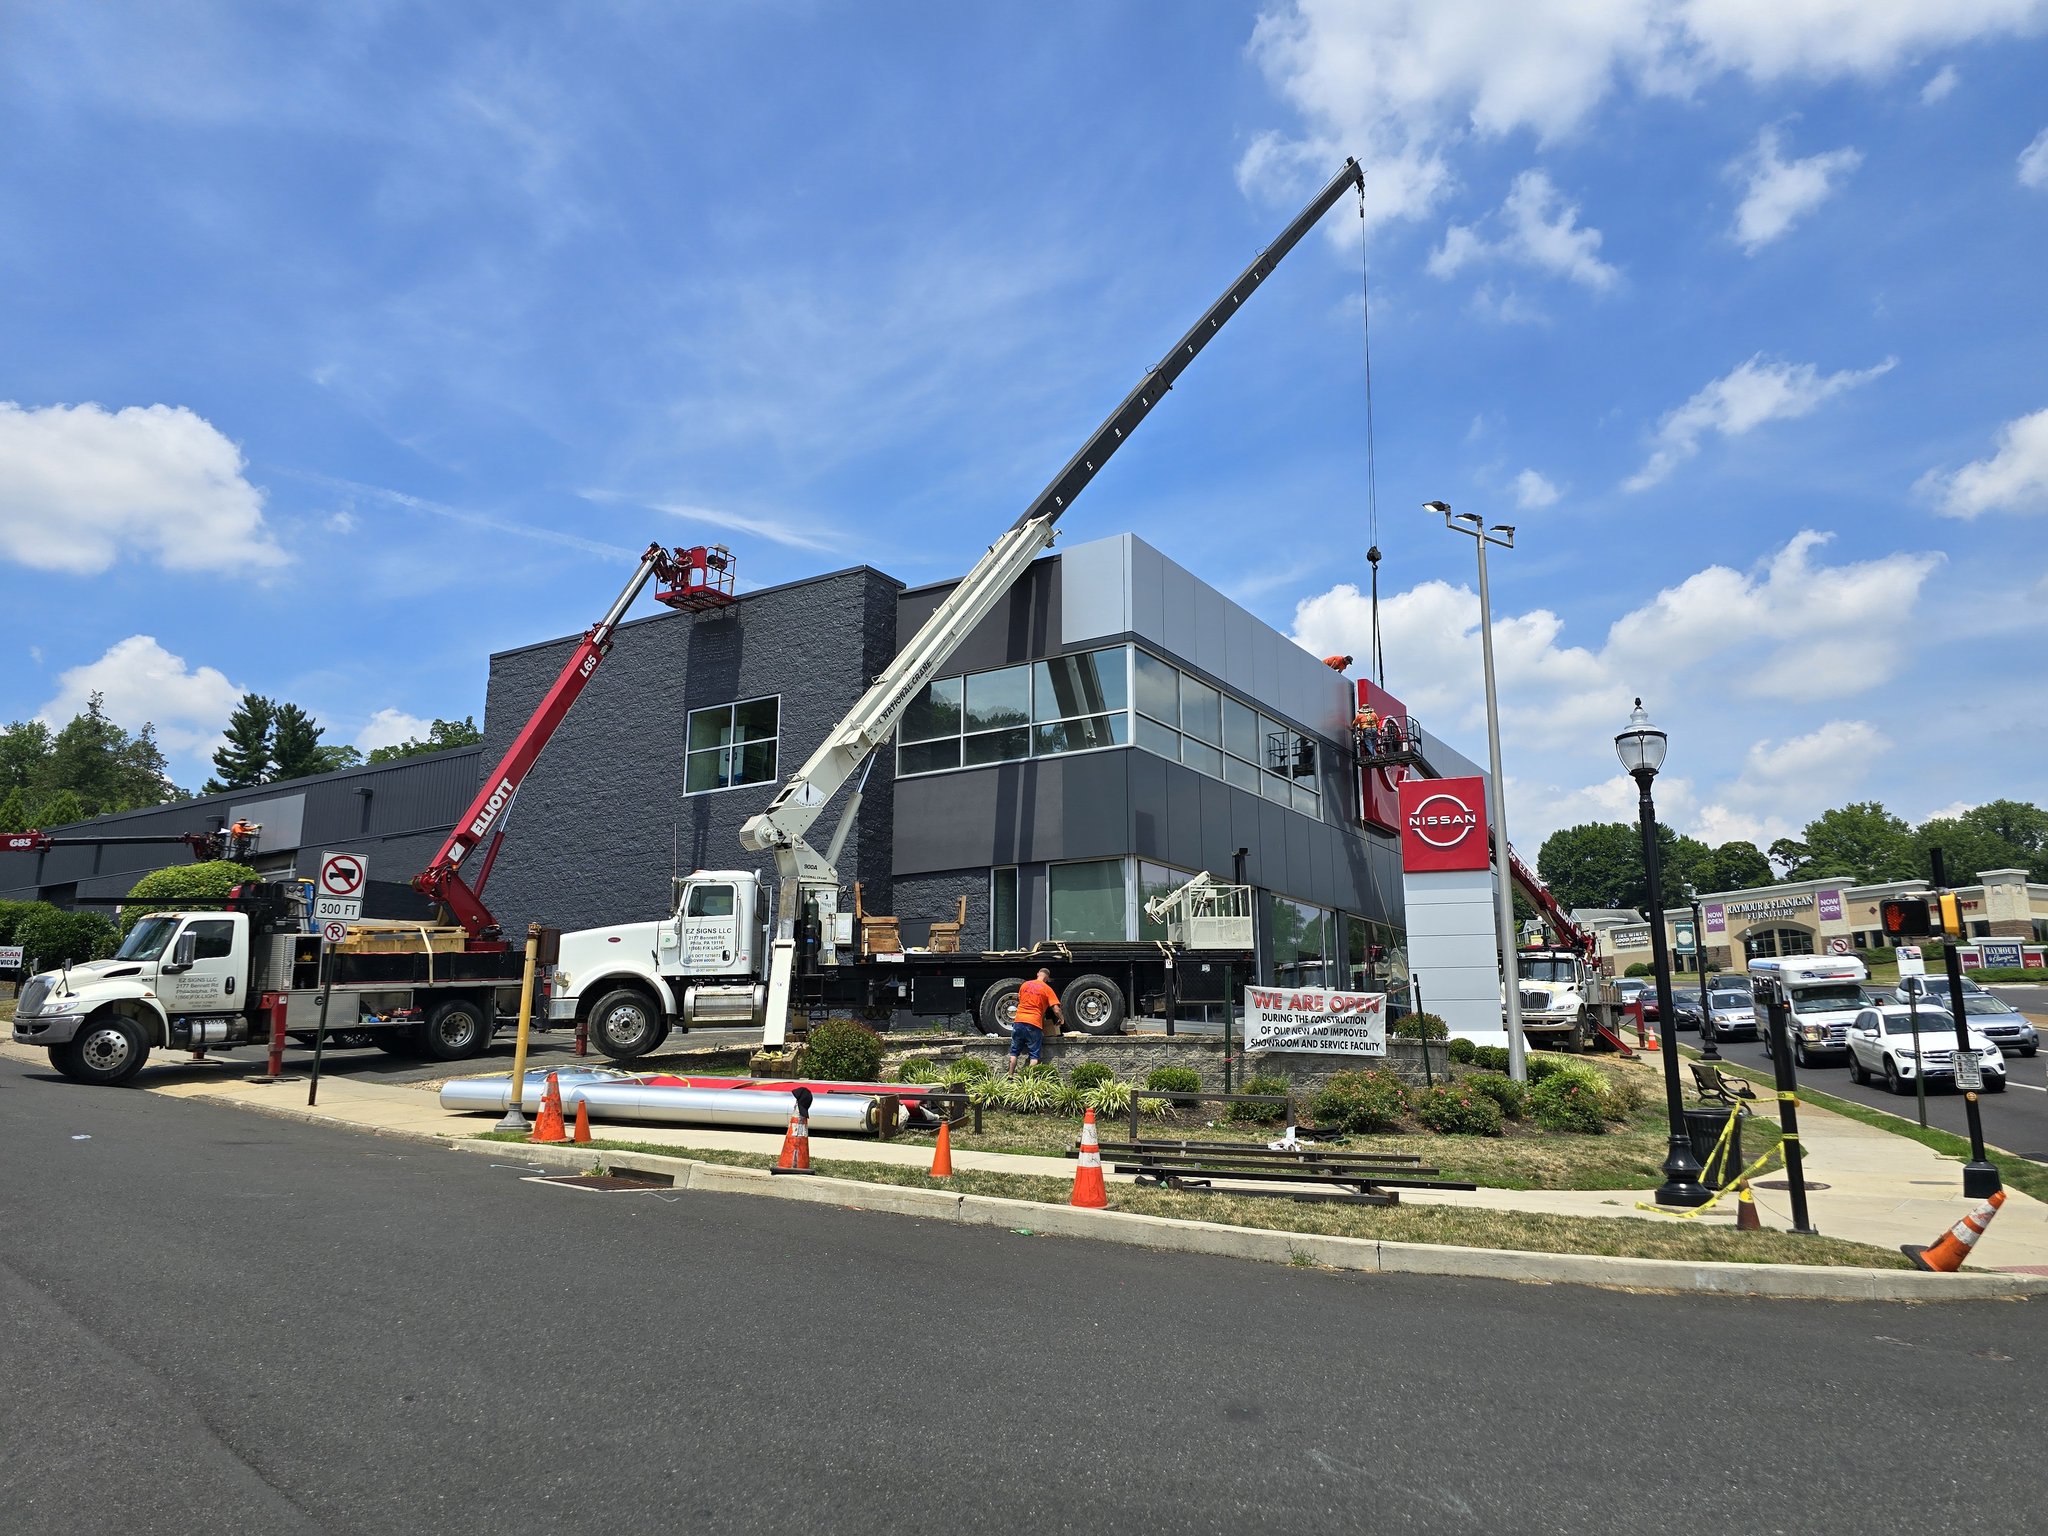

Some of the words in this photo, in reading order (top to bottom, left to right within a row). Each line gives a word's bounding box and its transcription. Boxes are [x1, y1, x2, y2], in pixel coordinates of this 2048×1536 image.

[579, 654, 597, 678] L65
[880, 683, 914, 720] NATIONAL
[912, 659, 932, 685] CRANE
[470, 777, 513, 837] ELLIOTT
[1409, 814, 1476, 826] NISSAN
[9, 838, 31, 847] G85
[1727, 902, 1764, 914] RAYMOUR
[1764, 901, 1771, 909] &
[1771, 895, 1815, 909] FLANIGAN
[1820, 897, 1839, 905] NOW
[320, 903, 341, 914] 300
[344, 904, 357, 916] FT
[1747, 908, 1795, 920] FURNITURE
[1820, 904, 1840, 913] OPEN
[1556, 903, 1574, 930] ELLIOTT
[1707, 911, 1723, 919] NOW
[1707, 917, 1724, 925] OPEN
[1984, 946, 2018, 954] RAYMOUR
[1251, 991, 1283, 1010] WE
[1288, 993, 1324, 1013] ARE
[1329, 995, 1381, 1014] OPEN
[1262, 1013, 1292, 1023] DURING
[1294, 1014, 1309, 1024] THE
[1310, 1015, 1367, 1025] CONSTRUCTION
[1260, 1025, 1272, 1035] OF
[1273, 1026, 1291, 1036] OUR
[1291, 1027, 1311, 1035] NEW
[1311, 1027, 1329, 1036] AND
[1330, 1027, 1368, 1038] IMPROVED
[1250, 1038, 1299, 1048] SHOWROOM
[1301, 1039, 1318, 1048] AND
[1320, 1040, 1348, 1050] SERVICE
[1350, 1041, 1381, 1051] FACILITY
